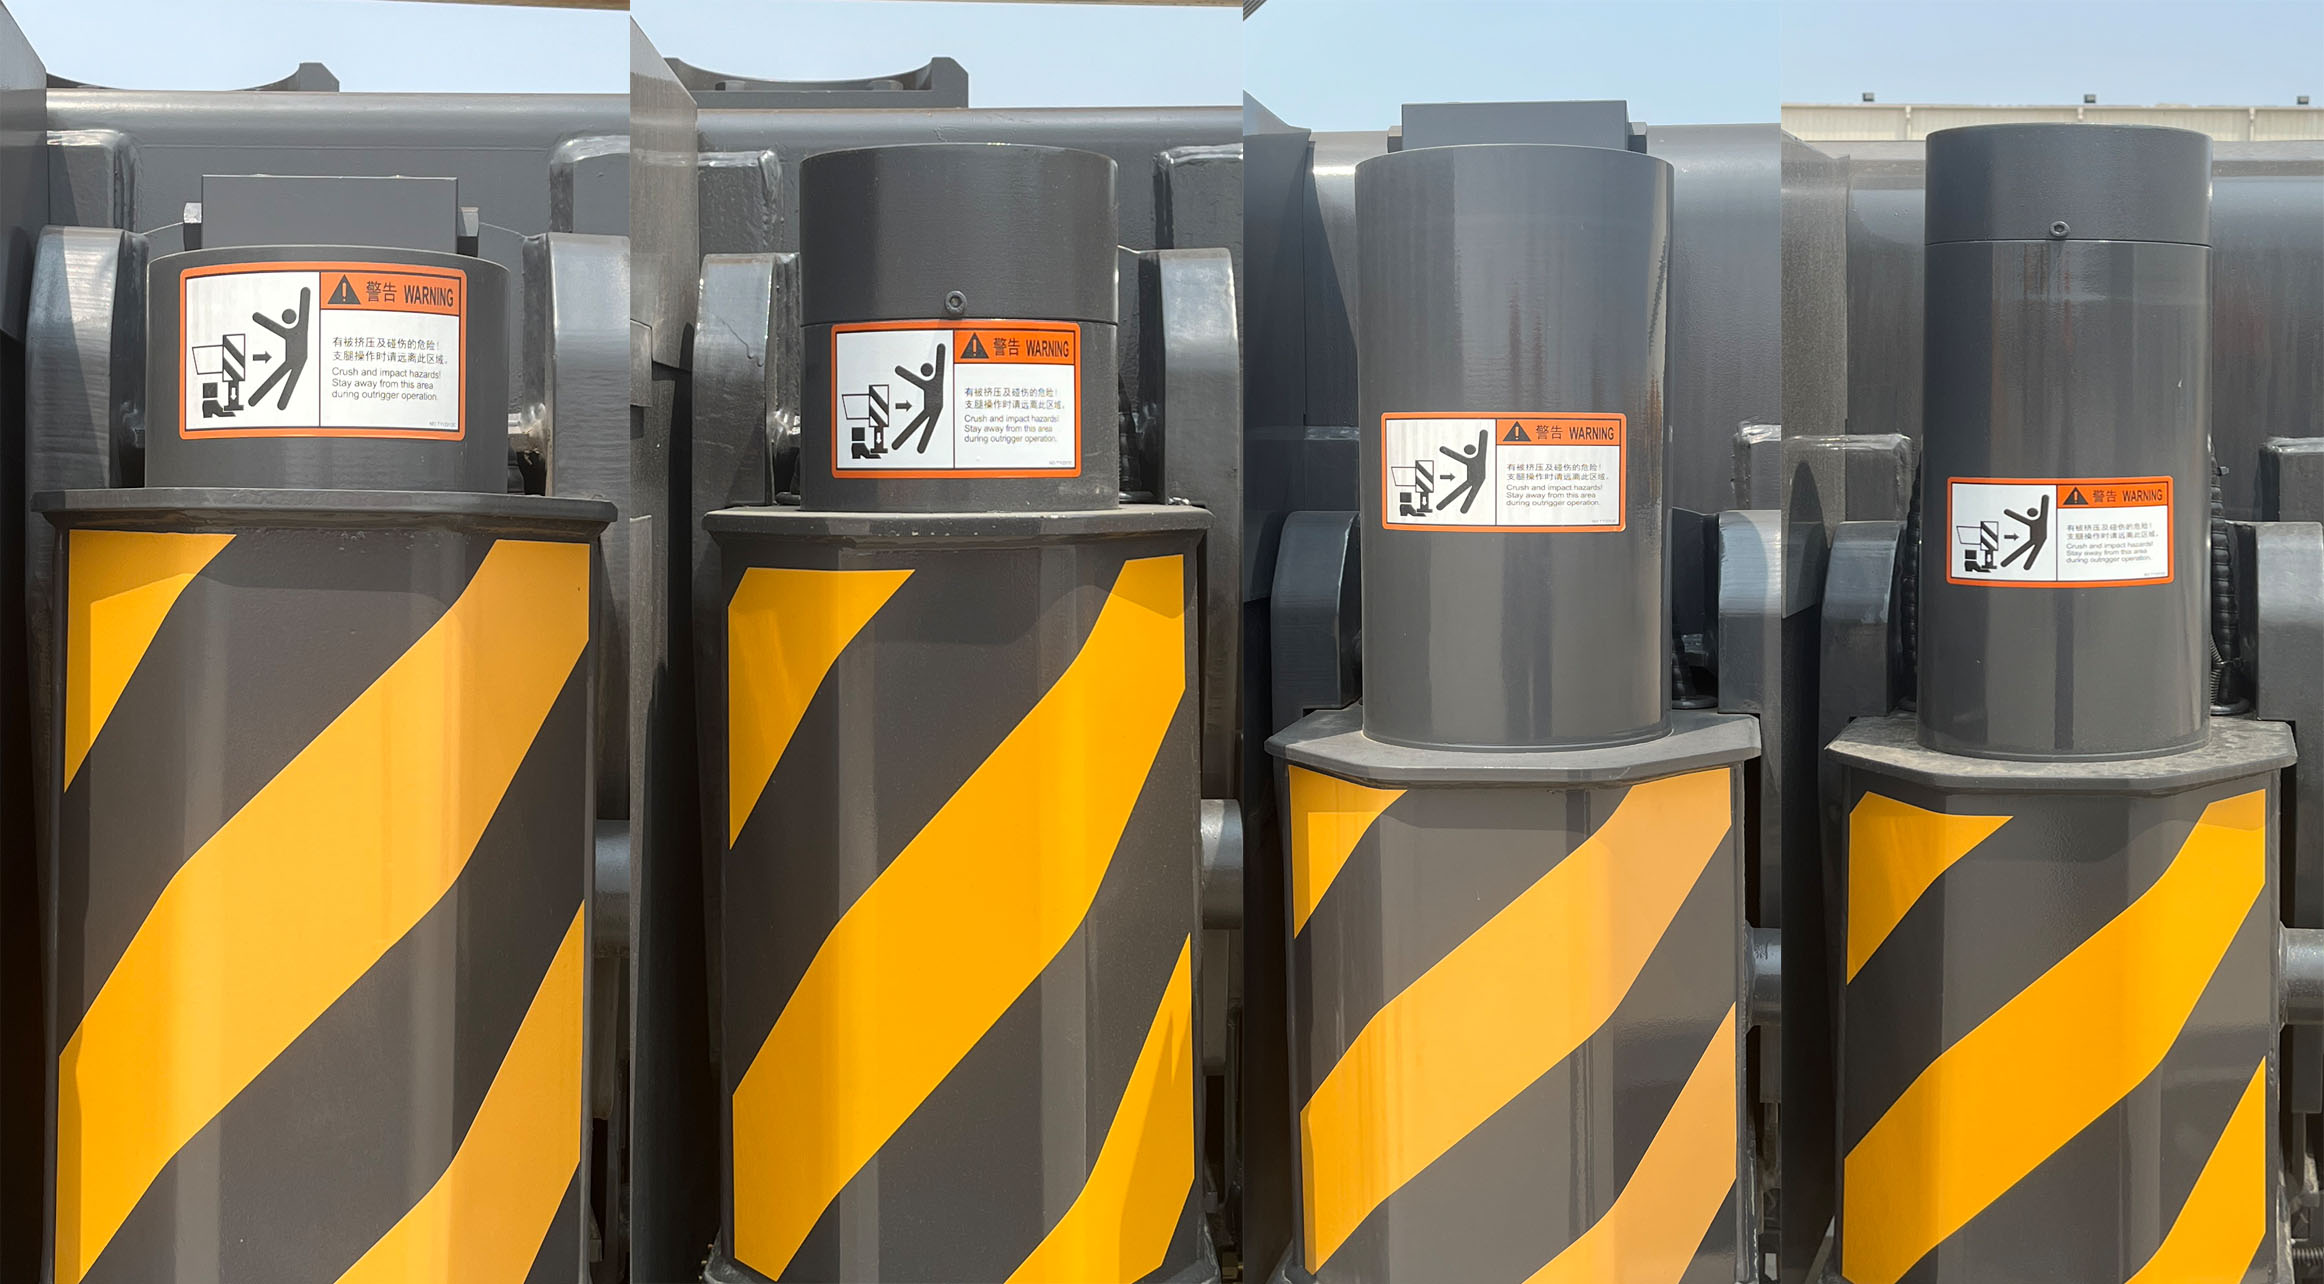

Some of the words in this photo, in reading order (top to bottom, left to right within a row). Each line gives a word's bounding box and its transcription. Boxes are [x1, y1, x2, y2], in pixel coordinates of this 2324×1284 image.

[366, 281, 397, 302] 警告
[404, 285, 454, 307] WARNING
[993, 338, 1020, 356] 警告
[1026, 340, 1069, 357] WARNING
[332, 367, 358, 376] Crush
[380, 369, 407, 378] impact
[409, 370, 441, 379] hazards!
[332, 379, 351, 388] Stay
[354, 381, 377, 389] away
[380, 380, 398, 388] from
[400, 380, 414, 389] this
[332, 390, 359, 400] during
[362, 391, 399, 401] outrigger
[401, 392, 437, 401] operation.
[1006, 415, 1030, 424] impact
[964, 425, 982, 433] Stay
[1536, 425, 1563, 440] 警告
[1569, 427, 1614, 440] WARNING
[964, 435, 988, 443] during
[990, 435, 1023, 444] outrigger
[2092, 490, 2117, 502] 警告
[2122, 489, 2163, 502] WARNING
